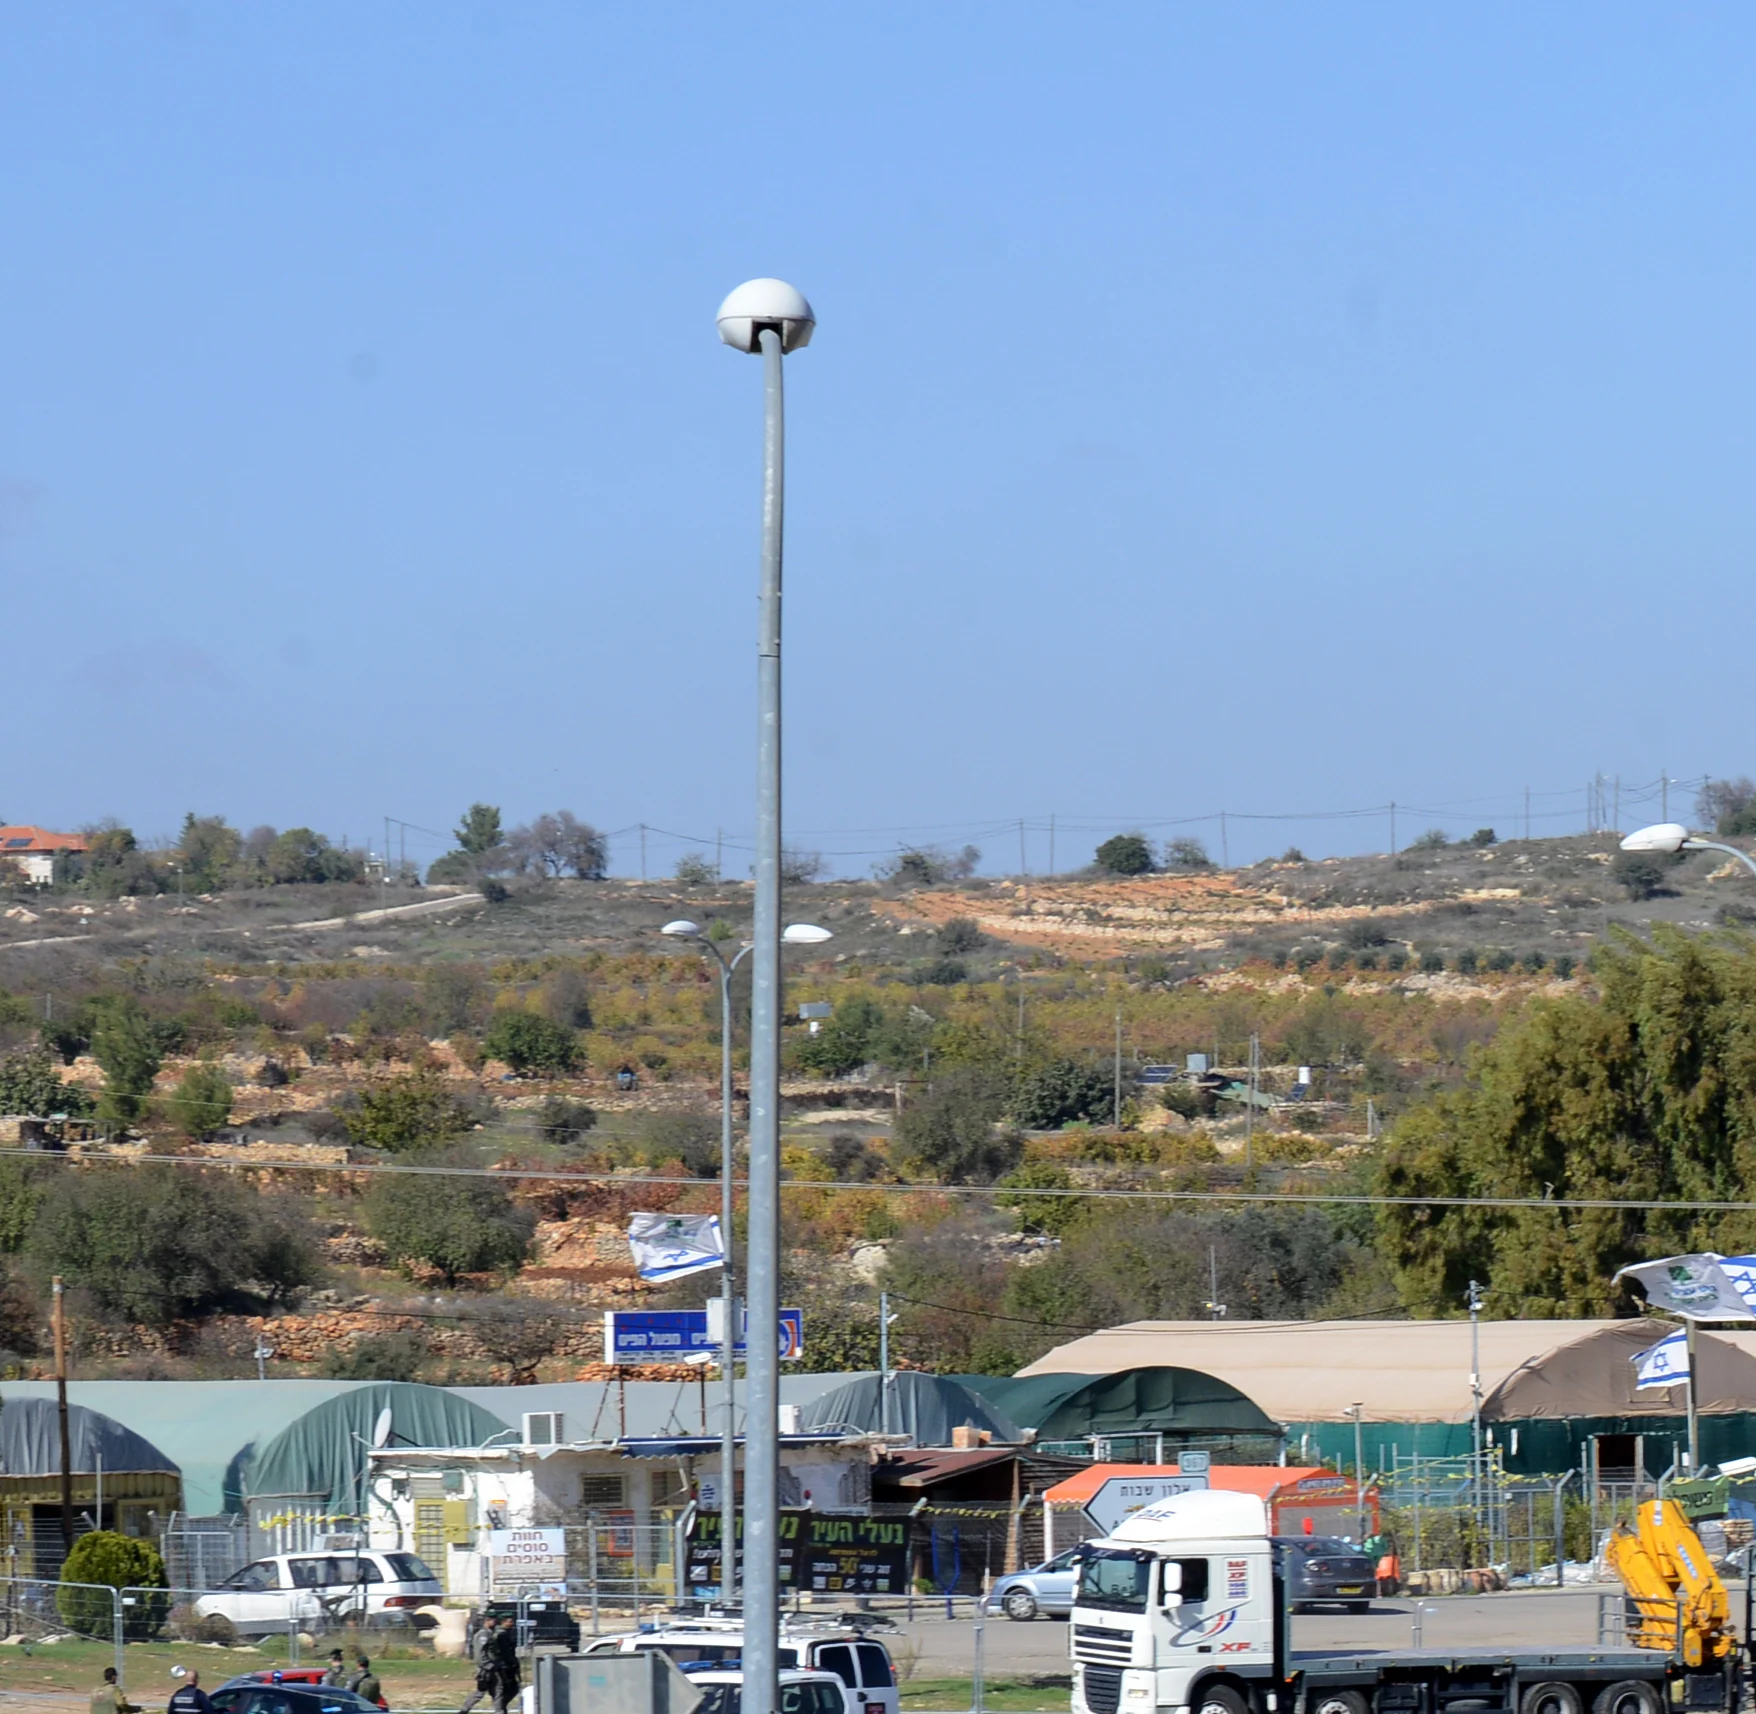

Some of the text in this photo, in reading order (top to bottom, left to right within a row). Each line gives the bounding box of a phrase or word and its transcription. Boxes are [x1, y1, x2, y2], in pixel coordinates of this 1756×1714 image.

[1120, 1485, 1155, 1497] שבות
[810, 1517, 904, 1544] נעלי העיר
[512, 1531, 543, 1542] חוות
[507, 1542, 548, 1553] סוסים
[502, 1554, 553, 1565] באפרת
[1219, 1642, 1251, 1652] XF
